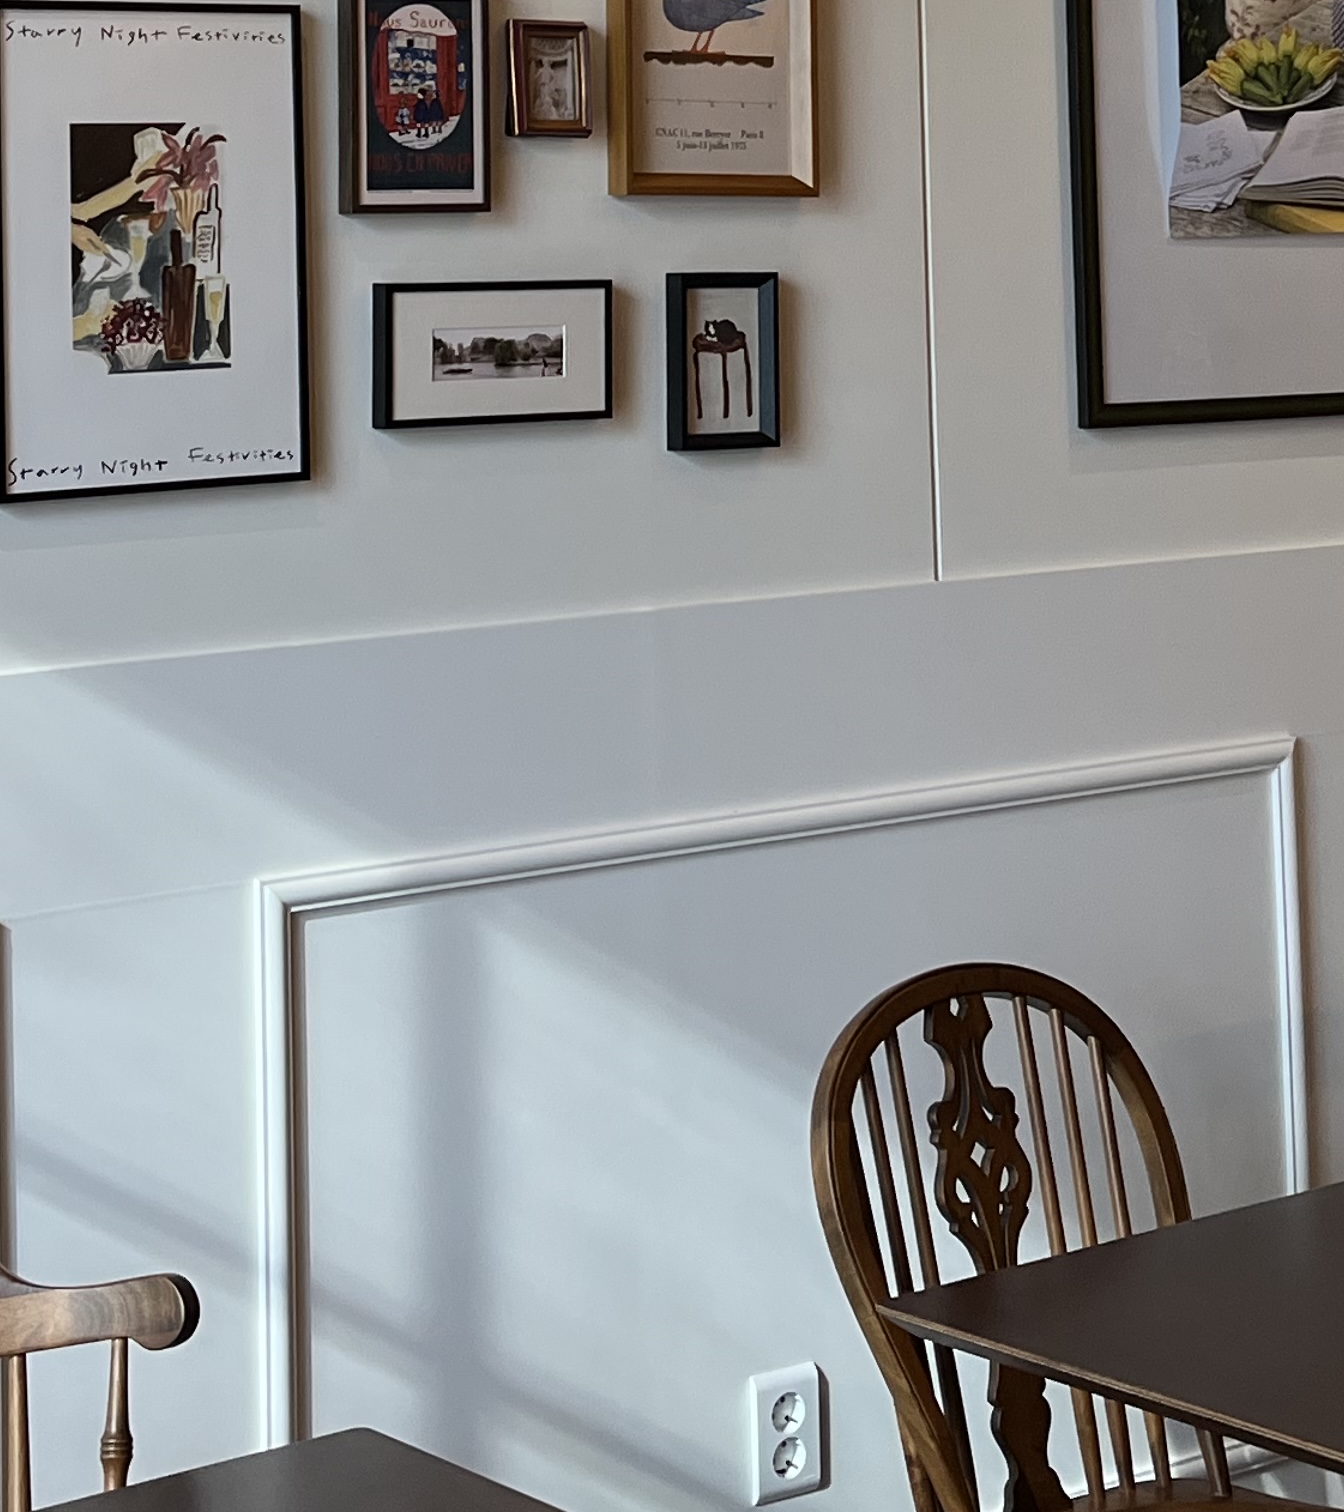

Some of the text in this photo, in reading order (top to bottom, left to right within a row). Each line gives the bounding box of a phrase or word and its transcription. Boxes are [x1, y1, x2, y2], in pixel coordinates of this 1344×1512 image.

[5, 20, 82, 47] Starry
[100, 25, 167, 46] Night
[7, 446, 295, 486] Starry Night Festivities
